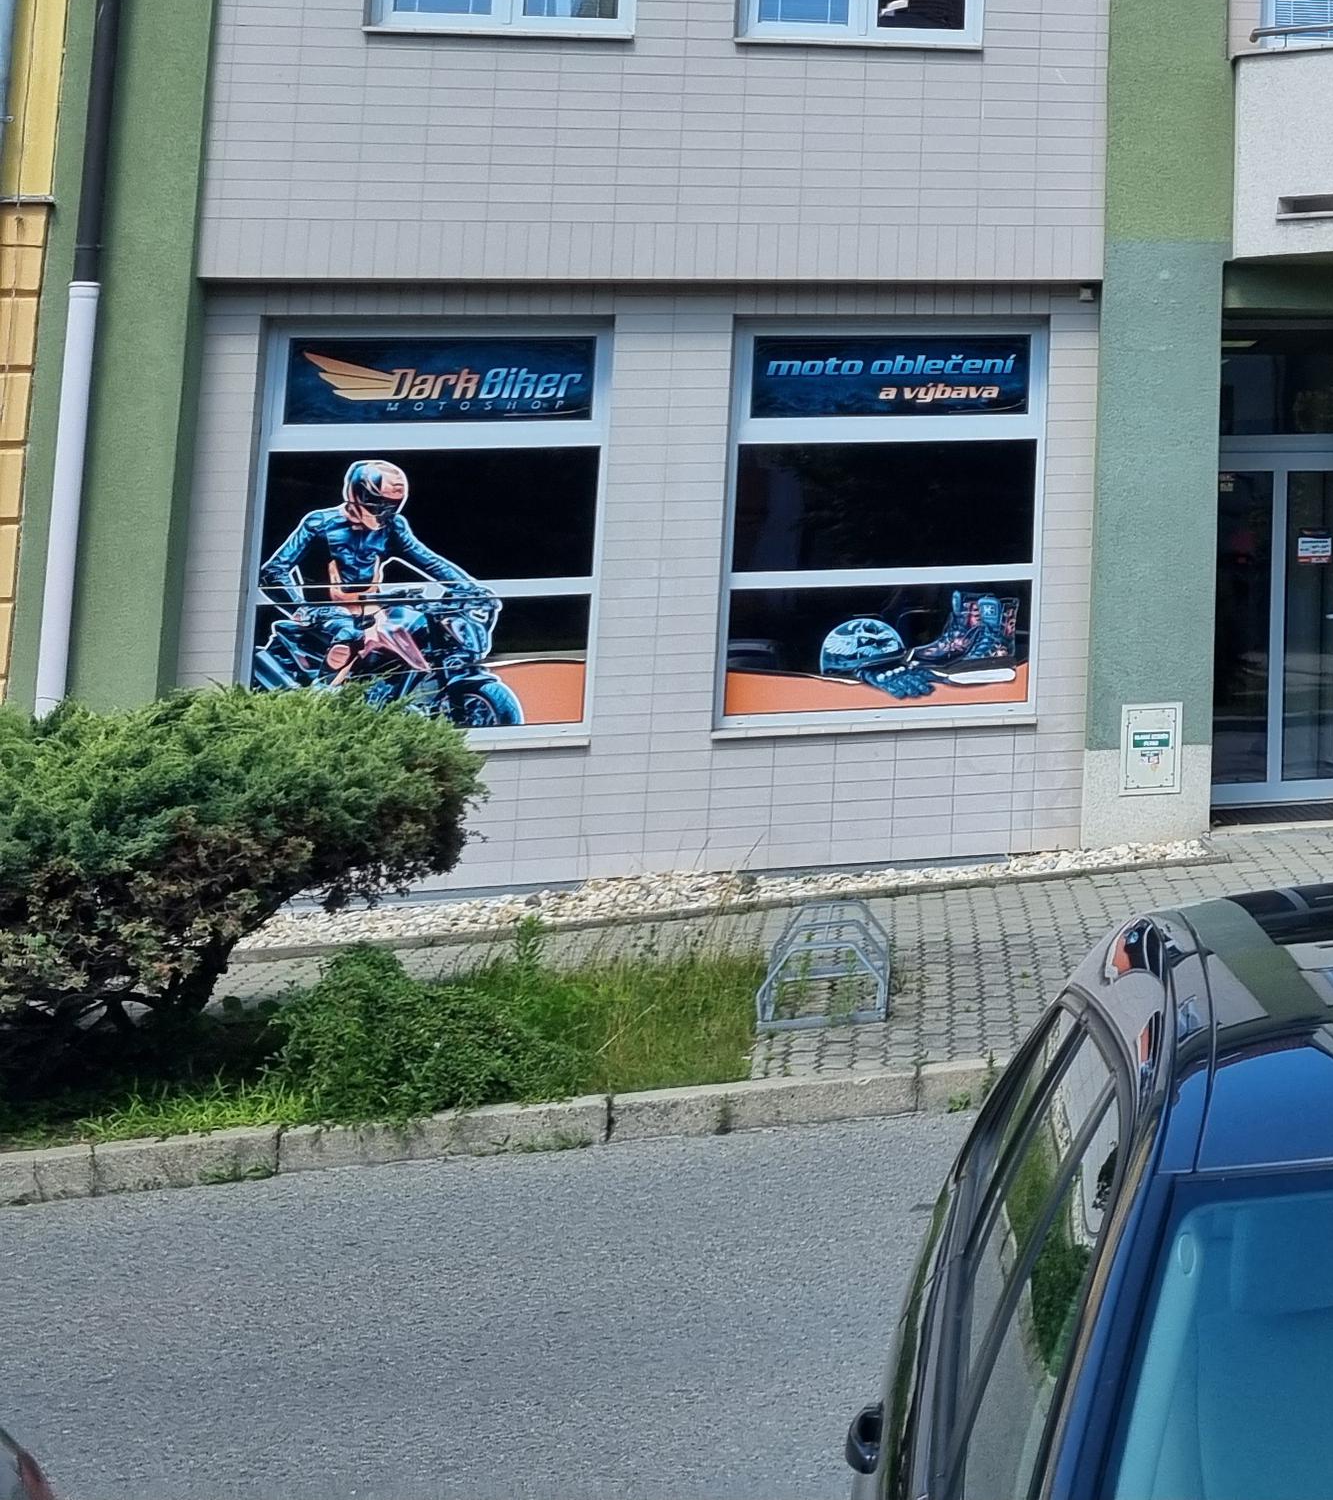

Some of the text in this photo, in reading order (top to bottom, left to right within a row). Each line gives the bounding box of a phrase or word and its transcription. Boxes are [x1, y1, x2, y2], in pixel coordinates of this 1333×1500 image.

[766, 354, 1016, 376] moto oblečení
[879, 382, 1000, 403] a výbava
[386, 401, 566, 412] MOTOSHOP
